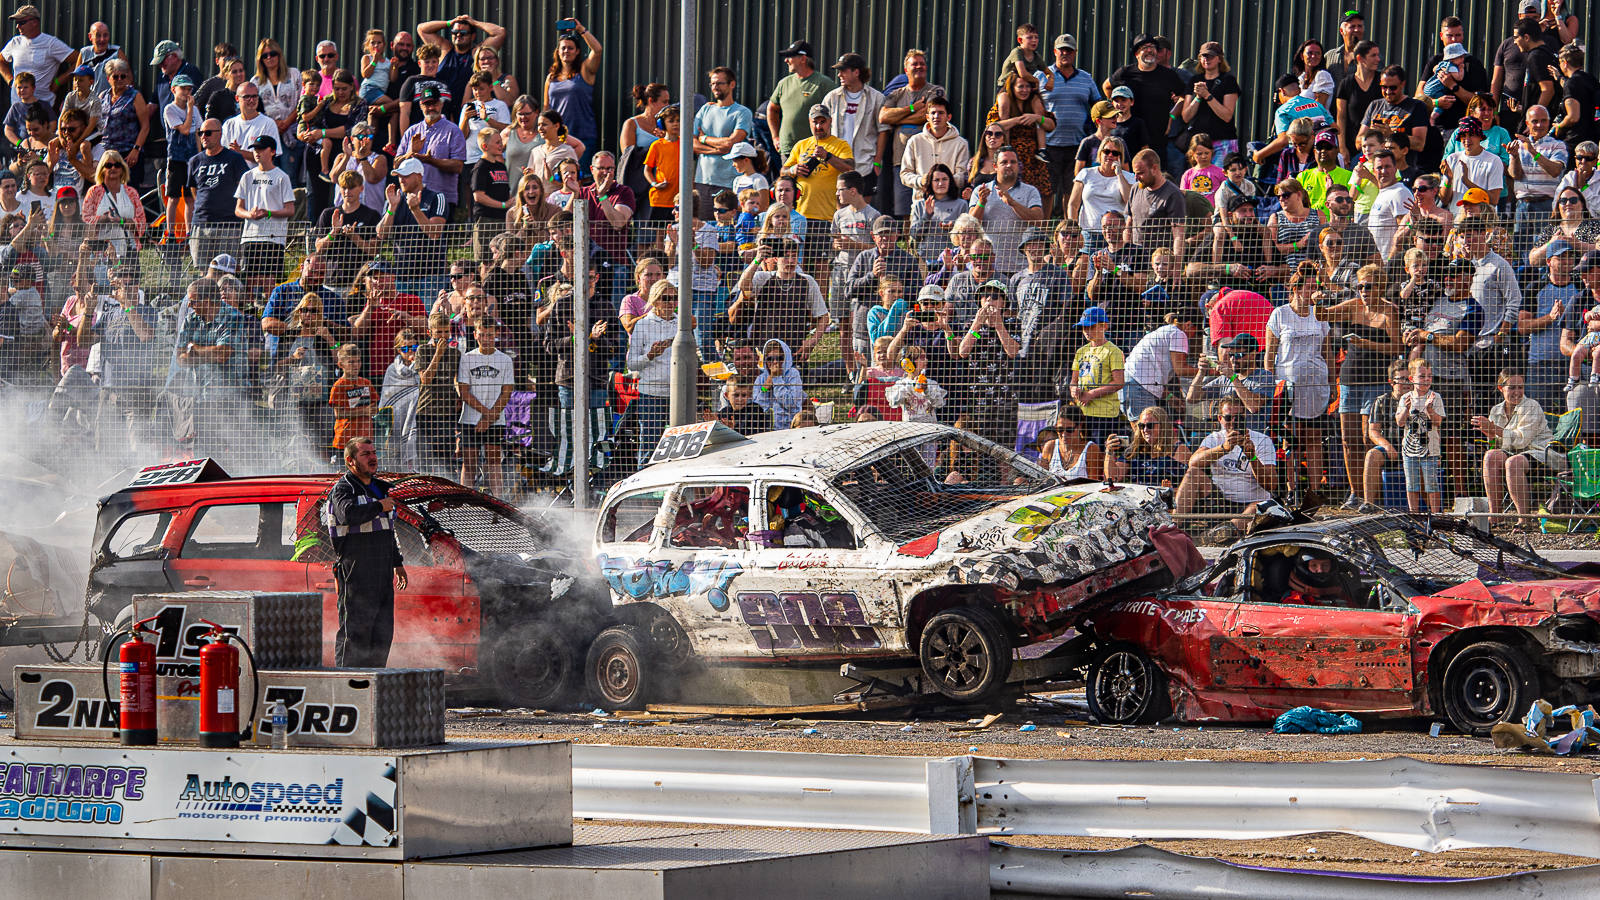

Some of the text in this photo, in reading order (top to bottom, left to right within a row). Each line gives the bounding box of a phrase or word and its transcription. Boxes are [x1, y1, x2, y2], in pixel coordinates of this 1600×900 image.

[197, 163, 228, 177] FOX
[653, 431, 708, 461] 908
[130, 467, 202, 486] 278
[737, 592, 883, 650] 908
[259, 686, 360, 735] 3RD
[179, 774, 344, 812] Autospeed
[178, 812, 341, 823] motorsport promoters
